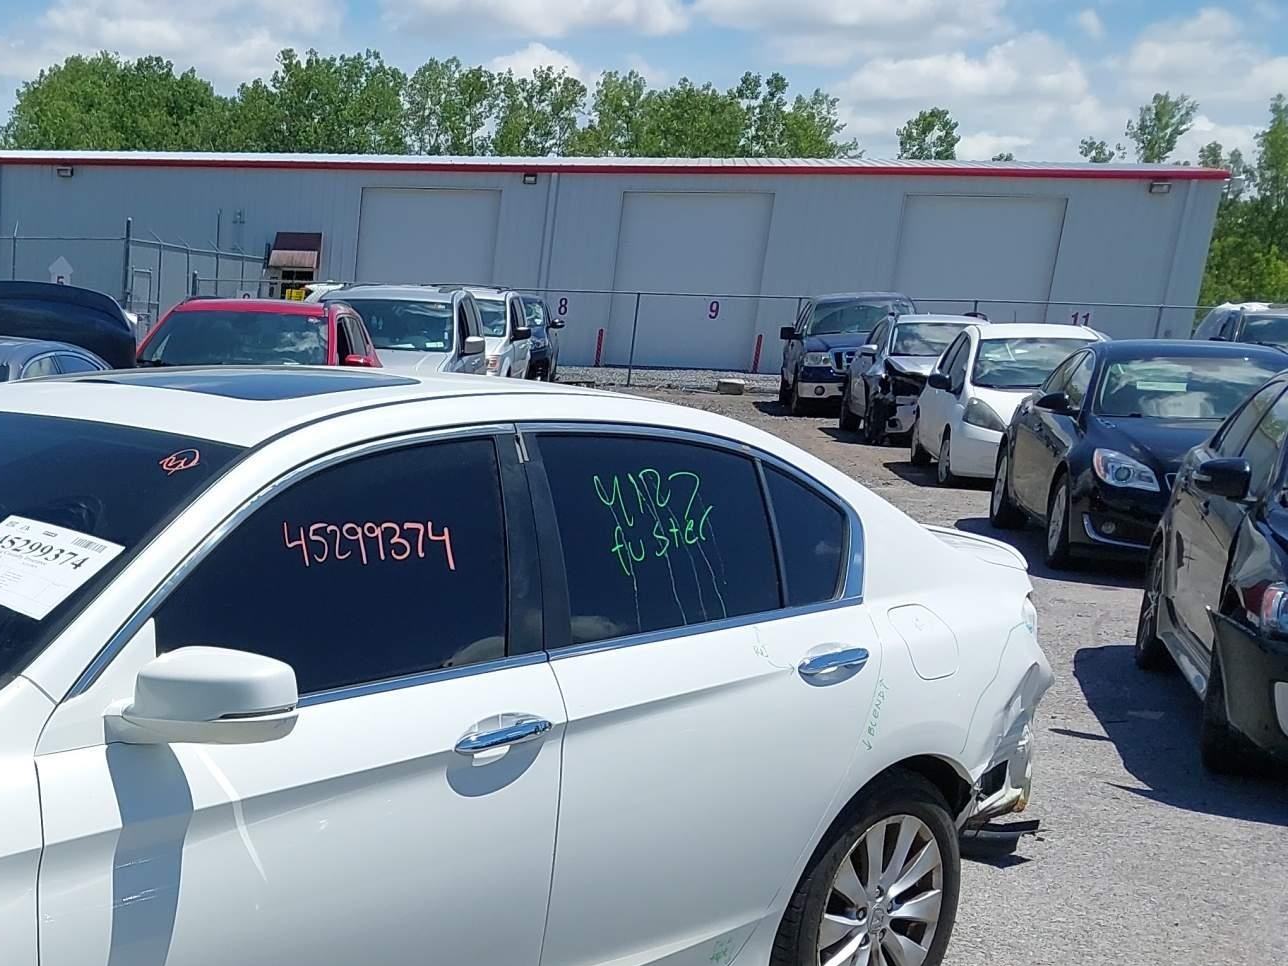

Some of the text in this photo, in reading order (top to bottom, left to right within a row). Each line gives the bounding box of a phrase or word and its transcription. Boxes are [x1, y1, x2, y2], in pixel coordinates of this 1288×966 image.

[558, 297, 568, 316] 8
[708, 300, 720, 319] 9
[1071, 311, 1090, 326] 11
[283, 521, 456, 571] 45299374
